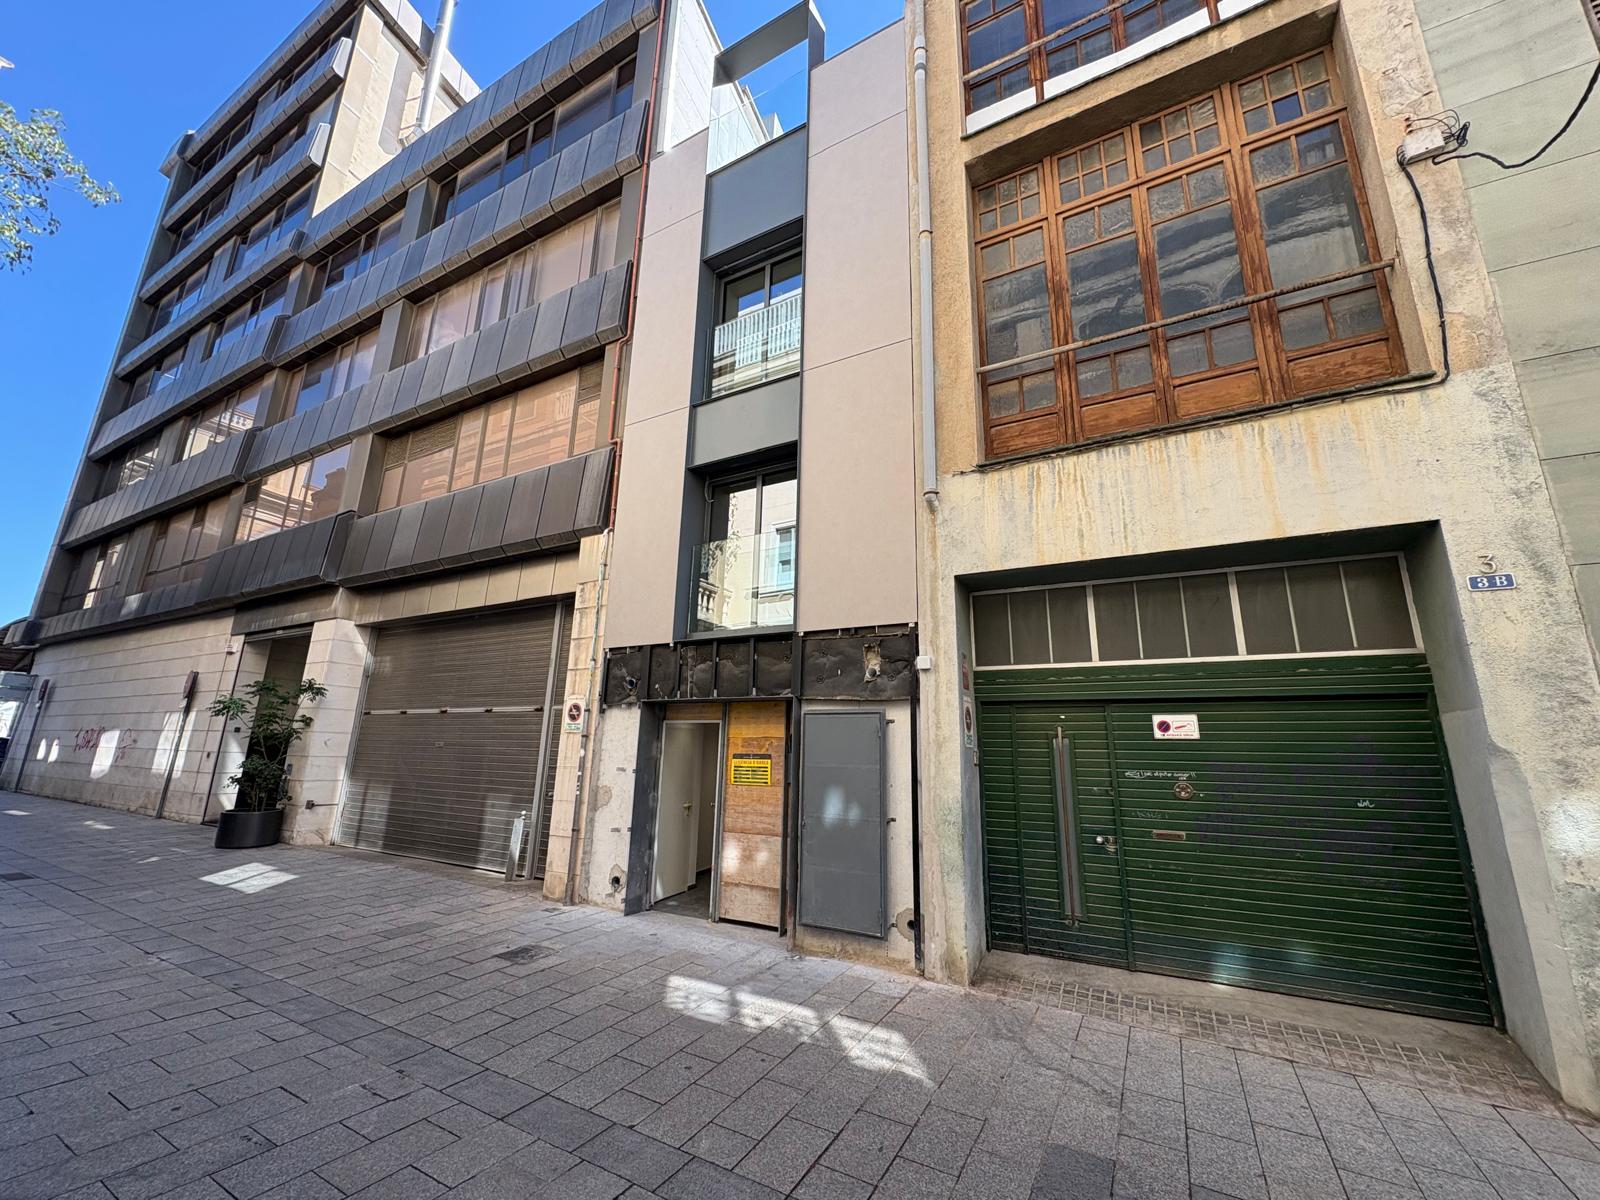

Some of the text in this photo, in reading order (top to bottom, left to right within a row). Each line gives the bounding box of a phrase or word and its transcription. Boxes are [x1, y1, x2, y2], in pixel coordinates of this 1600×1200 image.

[1479, 554, 1497, 573] 3
[1477, 575, 1508, 588] 3 B
